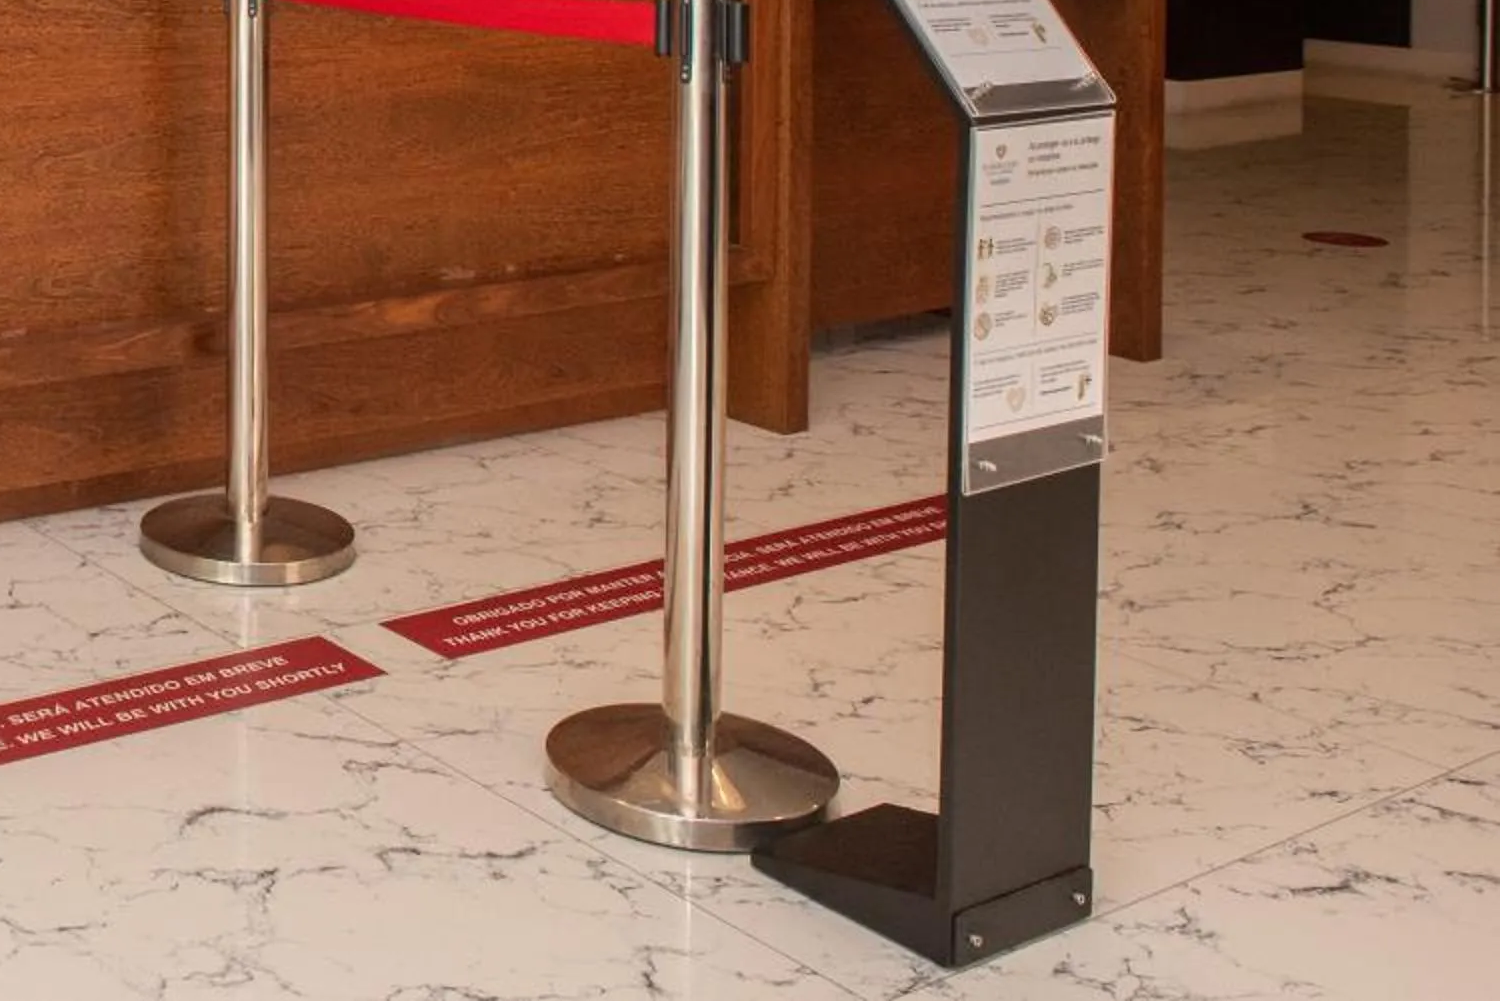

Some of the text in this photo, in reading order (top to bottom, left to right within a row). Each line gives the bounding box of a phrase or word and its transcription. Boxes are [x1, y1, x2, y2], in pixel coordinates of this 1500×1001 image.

[443, 590, 661, 647] THANK YOU FOR KEEPING
[452, 573, 655, 626] OBRIGADO POR MANTER
[7, 702, 71, 726] SERÁ
[75, 680, 181, 711] ATENDIDO
[184, 671, 217, 687] EM
[219, 655, 288, 678] BREVE
[16, 728, 57, 744] WE
[56, 716, 113, 736] WILL
[116, 708, 147, 723] BE
[151, 693, 205, 715] WITH
[206, 682, 252, 701] YOU
[254, 662, 347, 690] SHORTLY
